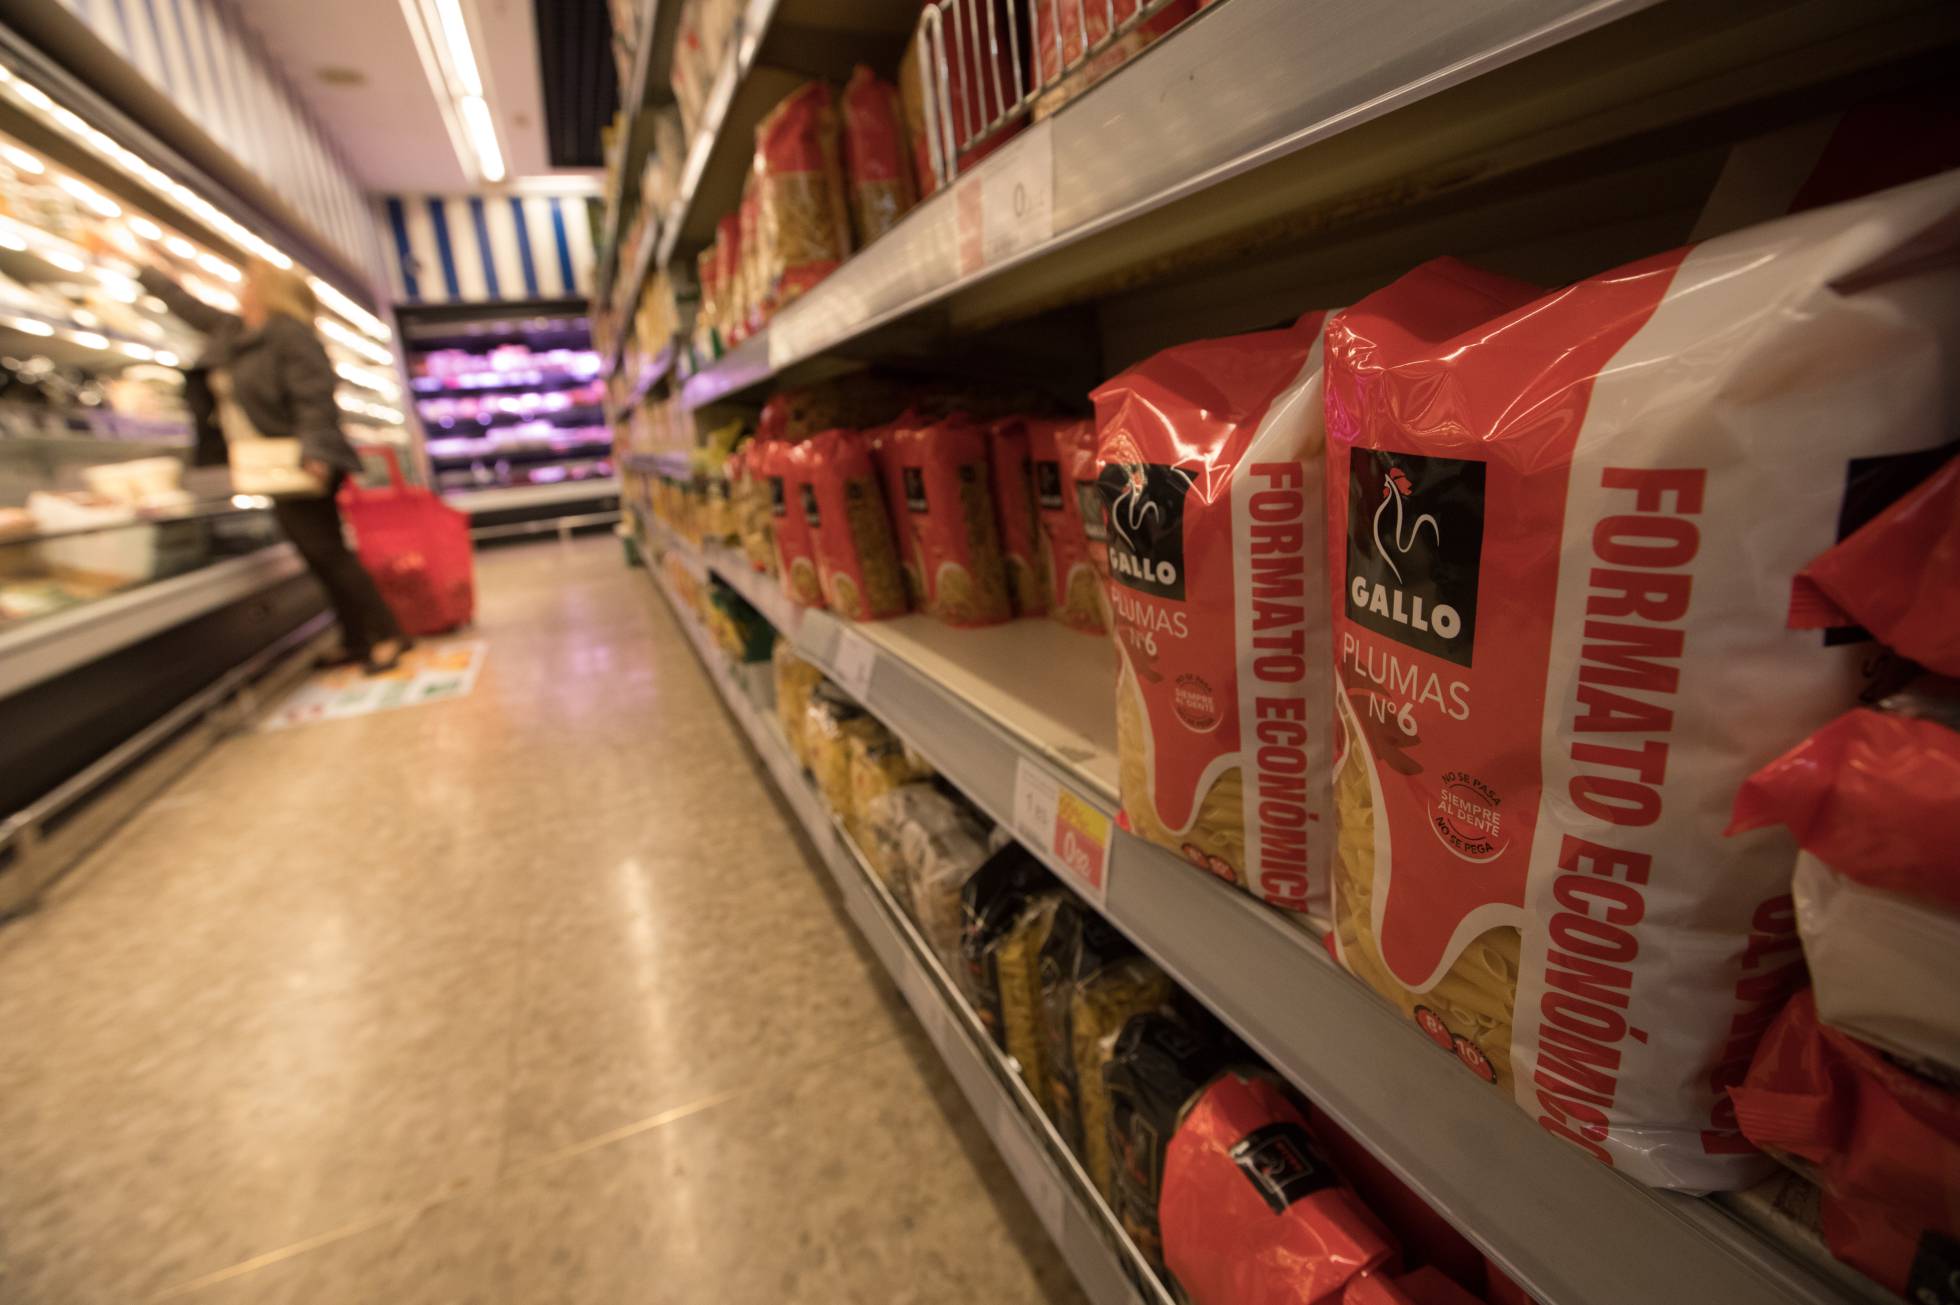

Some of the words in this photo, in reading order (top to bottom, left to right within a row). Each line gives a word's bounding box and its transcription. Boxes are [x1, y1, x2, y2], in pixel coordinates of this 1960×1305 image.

[1249, 462, 1306, 683] FORMATO
[1110, 585, 1189, 639] PLUMAS
[1351, 575, 1462, 639] GALLO
[1568, 467, 1708, 827] FORMATO
[1343, 631, 1471, 721] PLUMAS
[1440, 788, 1501, 826] SIEMPRE
[1441, 771, 1456, 785] NO
[1457, 772, 1470, 784] SE
[1472, 779, 1502, 806] PASA
[1436, 816, 1450, 836] NO
[1450, 835, 1463, 848] SE
[1464, 842, 1494, 855] PEGA
[1438, 801, 1454, 816] AL
[1457, 809, 1500, 838] DENTE
